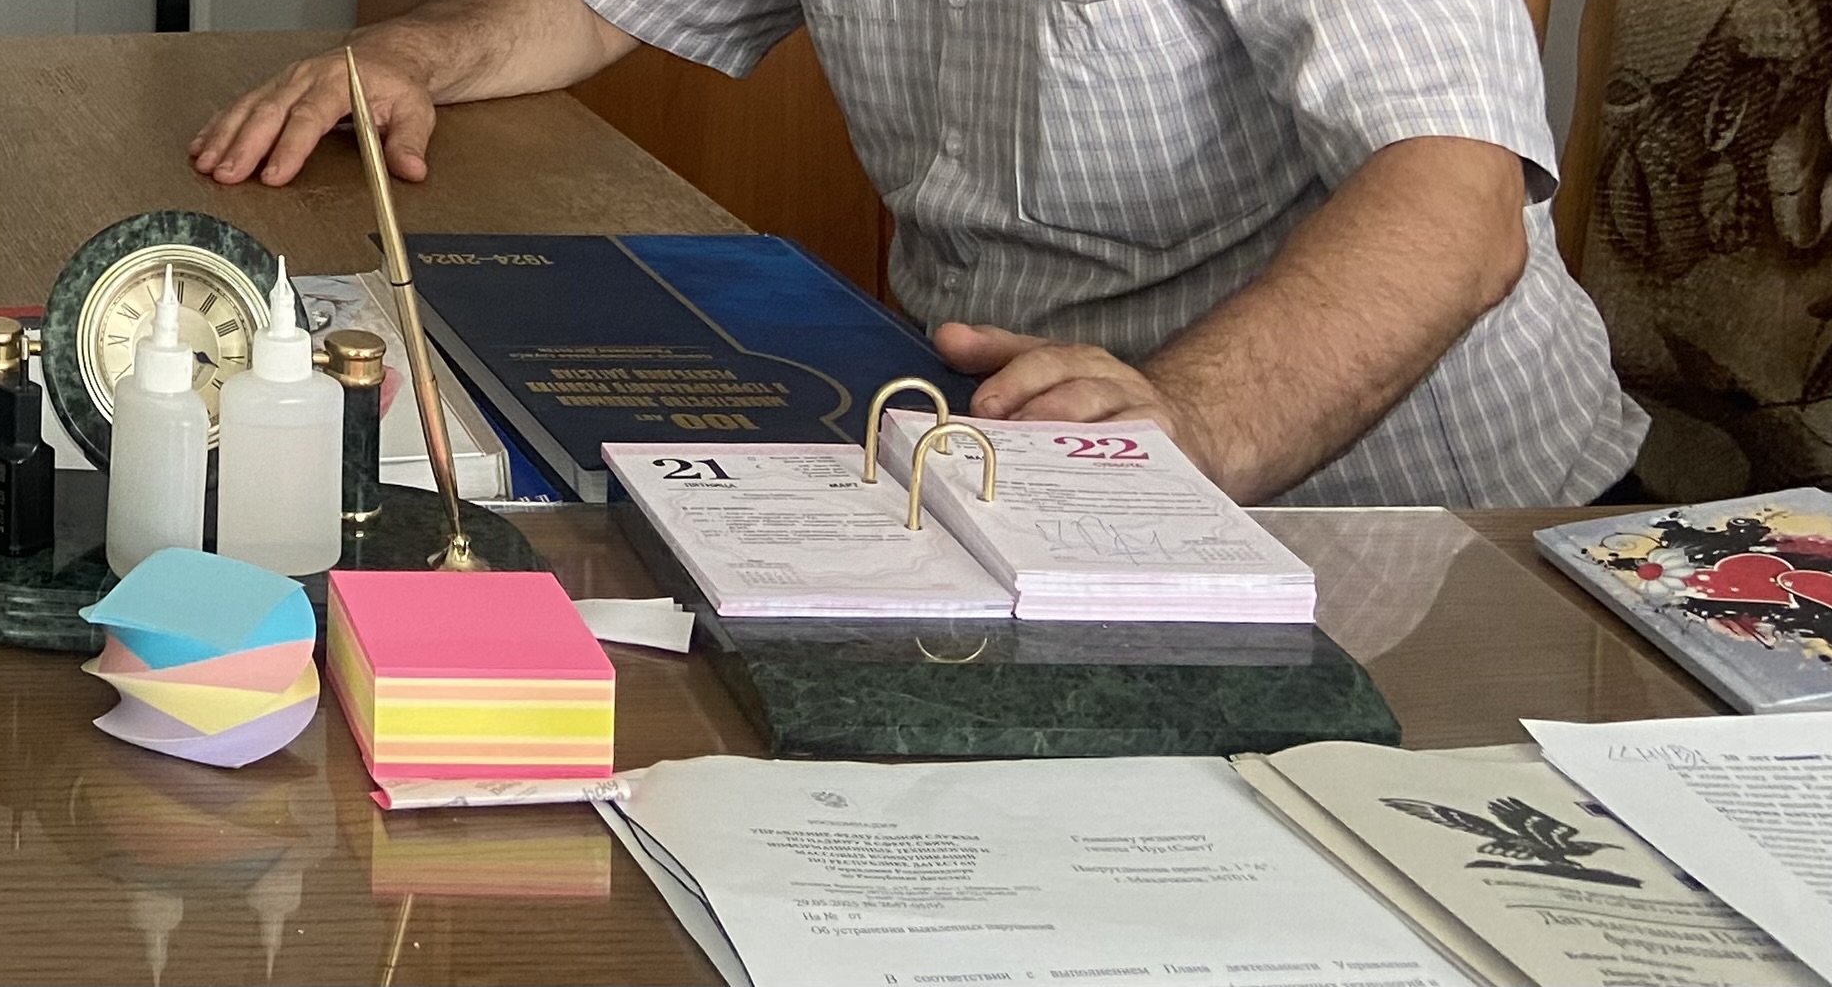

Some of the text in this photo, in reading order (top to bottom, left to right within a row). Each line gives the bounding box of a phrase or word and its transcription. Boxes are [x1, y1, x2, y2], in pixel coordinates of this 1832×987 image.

[670, 413, 760, 430] 100
[1053, 436, 1149, 461] 22
[652, 458, 741, 480] 21
[811, 924, 830, 934] Об
[832, 925, 906, 936] устранении
[884, 973, 898, 985] В
[914, 972, 1012, 984] соответствии
[1050, 966, 1151, 979] выполнением
[1163, 963, 1211, 975] Плана
